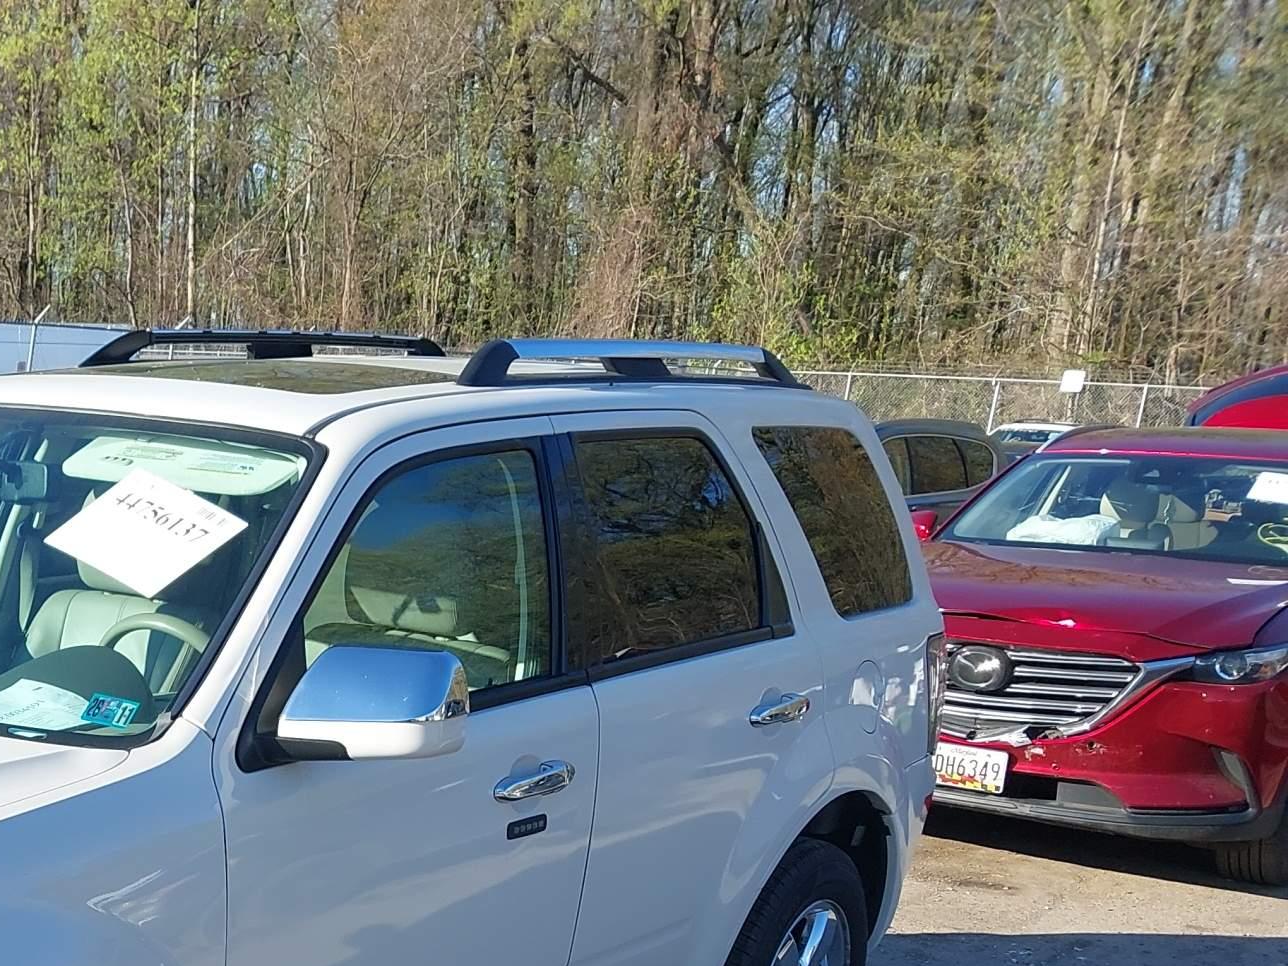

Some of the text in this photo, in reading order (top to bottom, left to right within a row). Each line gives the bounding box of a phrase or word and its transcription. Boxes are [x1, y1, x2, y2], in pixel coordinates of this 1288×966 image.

[116, 492, 210, 542] 44756137
[86, 698, 136, 727] 26 11
[934, 753, 1001, 782] DH6349
